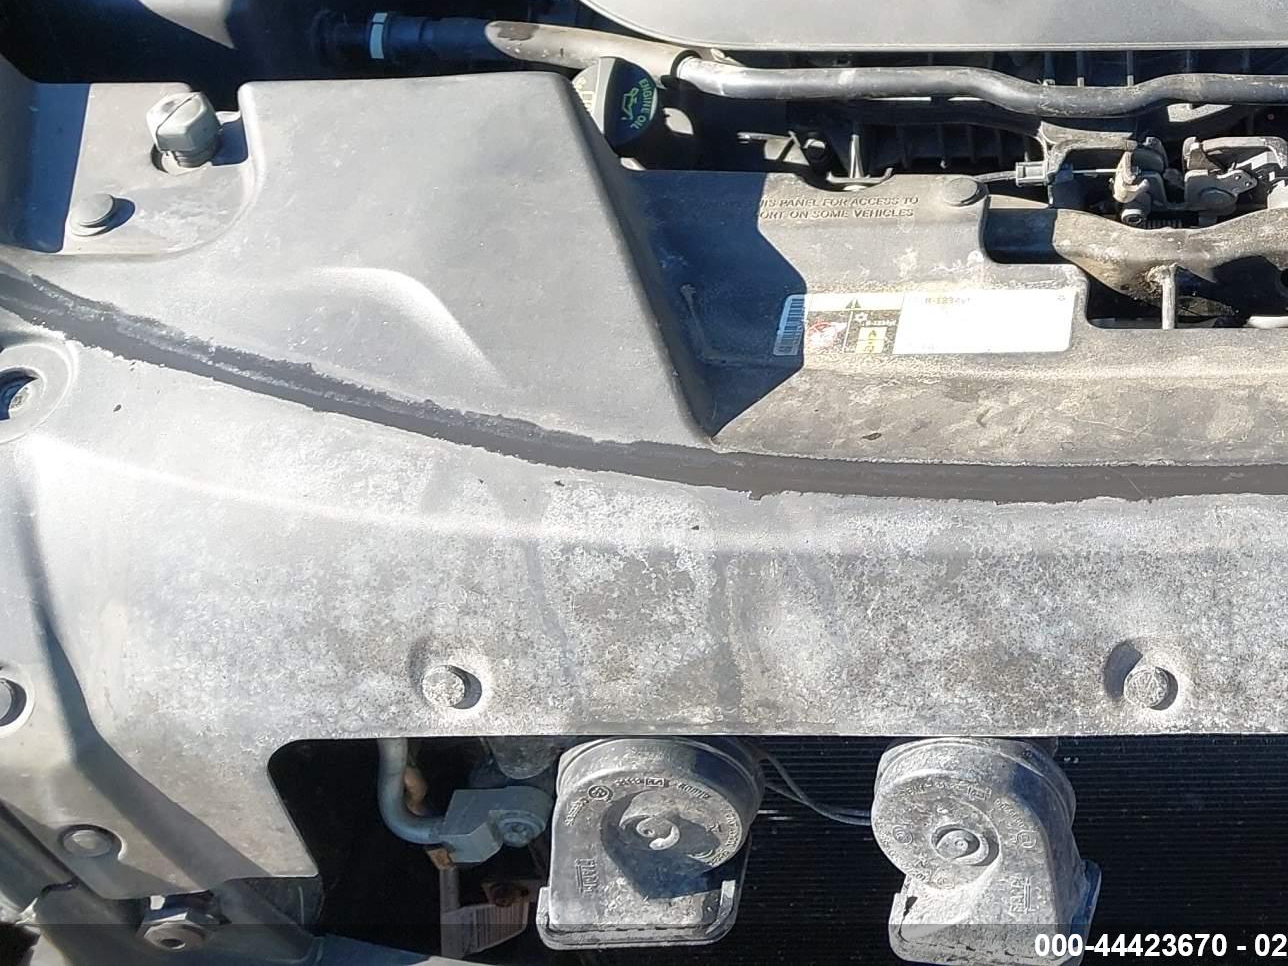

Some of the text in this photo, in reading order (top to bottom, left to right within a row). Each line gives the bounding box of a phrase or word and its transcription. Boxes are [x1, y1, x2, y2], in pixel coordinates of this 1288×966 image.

[630, 77, 654, 130] ENGINE OIL
[779, 197, 821, 208] PANEL
[822, 196, 848, 207] FOR
[850, 195, 899, 207] ACCESS
[902, 195, 920, 206] TO
[789, 209, 809, 220] ON
[811, 209, 850, 220] SOME
[853, 208, 915, 219] VEHICLES
